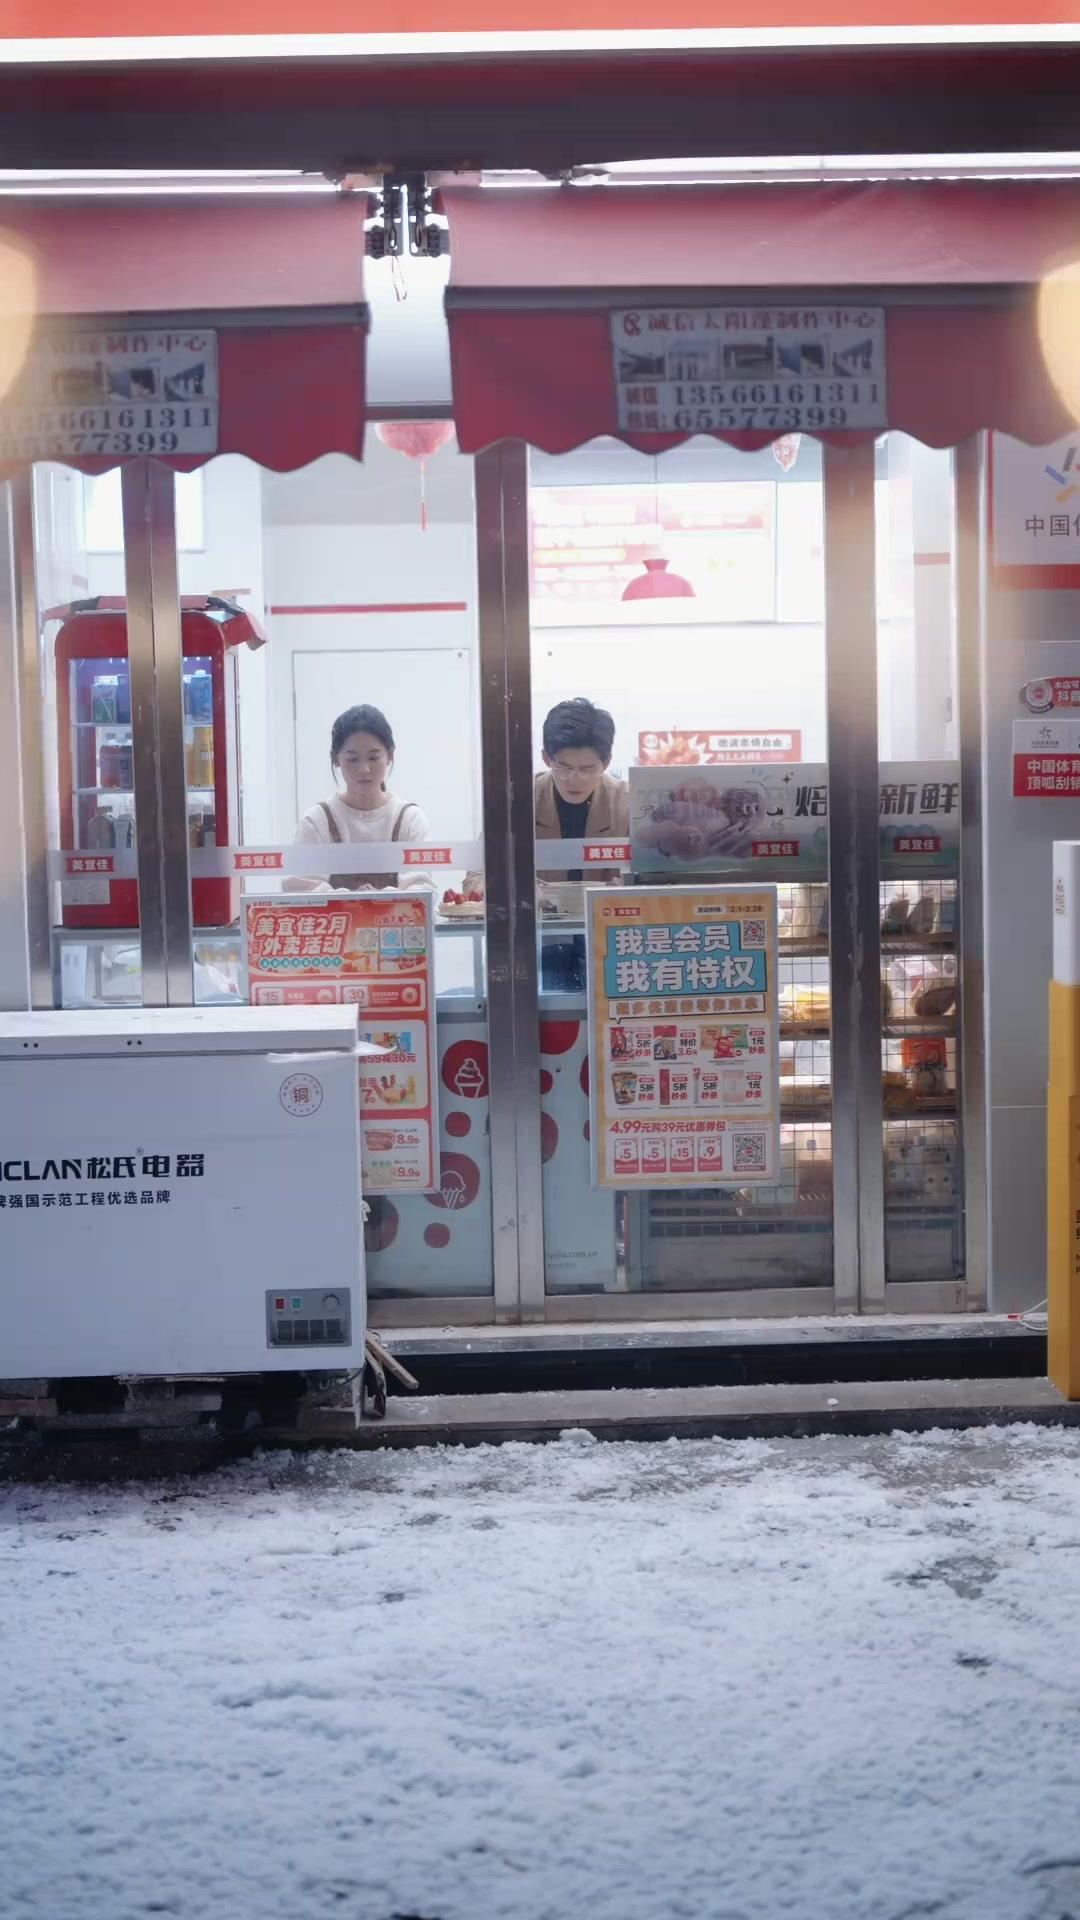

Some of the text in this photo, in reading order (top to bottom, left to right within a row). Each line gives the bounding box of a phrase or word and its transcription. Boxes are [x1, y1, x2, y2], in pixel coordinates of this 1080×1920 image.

[673, 383, 878, 405] 13566161311
[674, 407, 847, 429] 65577399
[879, 782, 960, 815] 新鲜
[409, 851, 447, 864] 美宜佳
[590, 847, 625, 859] 美宜佳
[758, 843, 793, 856] 美宜佳
[71, 860, 109, 872] 美宜佳
[240, 855, 278, 868] 美宜佳
[255, 914, 350, 937] 美宜佳2月
[262, 936, 343, 957] 外卖活动
[616, 925, 730, 955] 我是会员
[616, 955, 755, 993] 我有特权
[680, 1038, 696, 1046] 特价
[294, 1087, 308, 1103] 铜
[609, 1119, 726, 1134] 4.99元购39元优惠券包
[87, 1154, 205, 1179] 松氏电器
